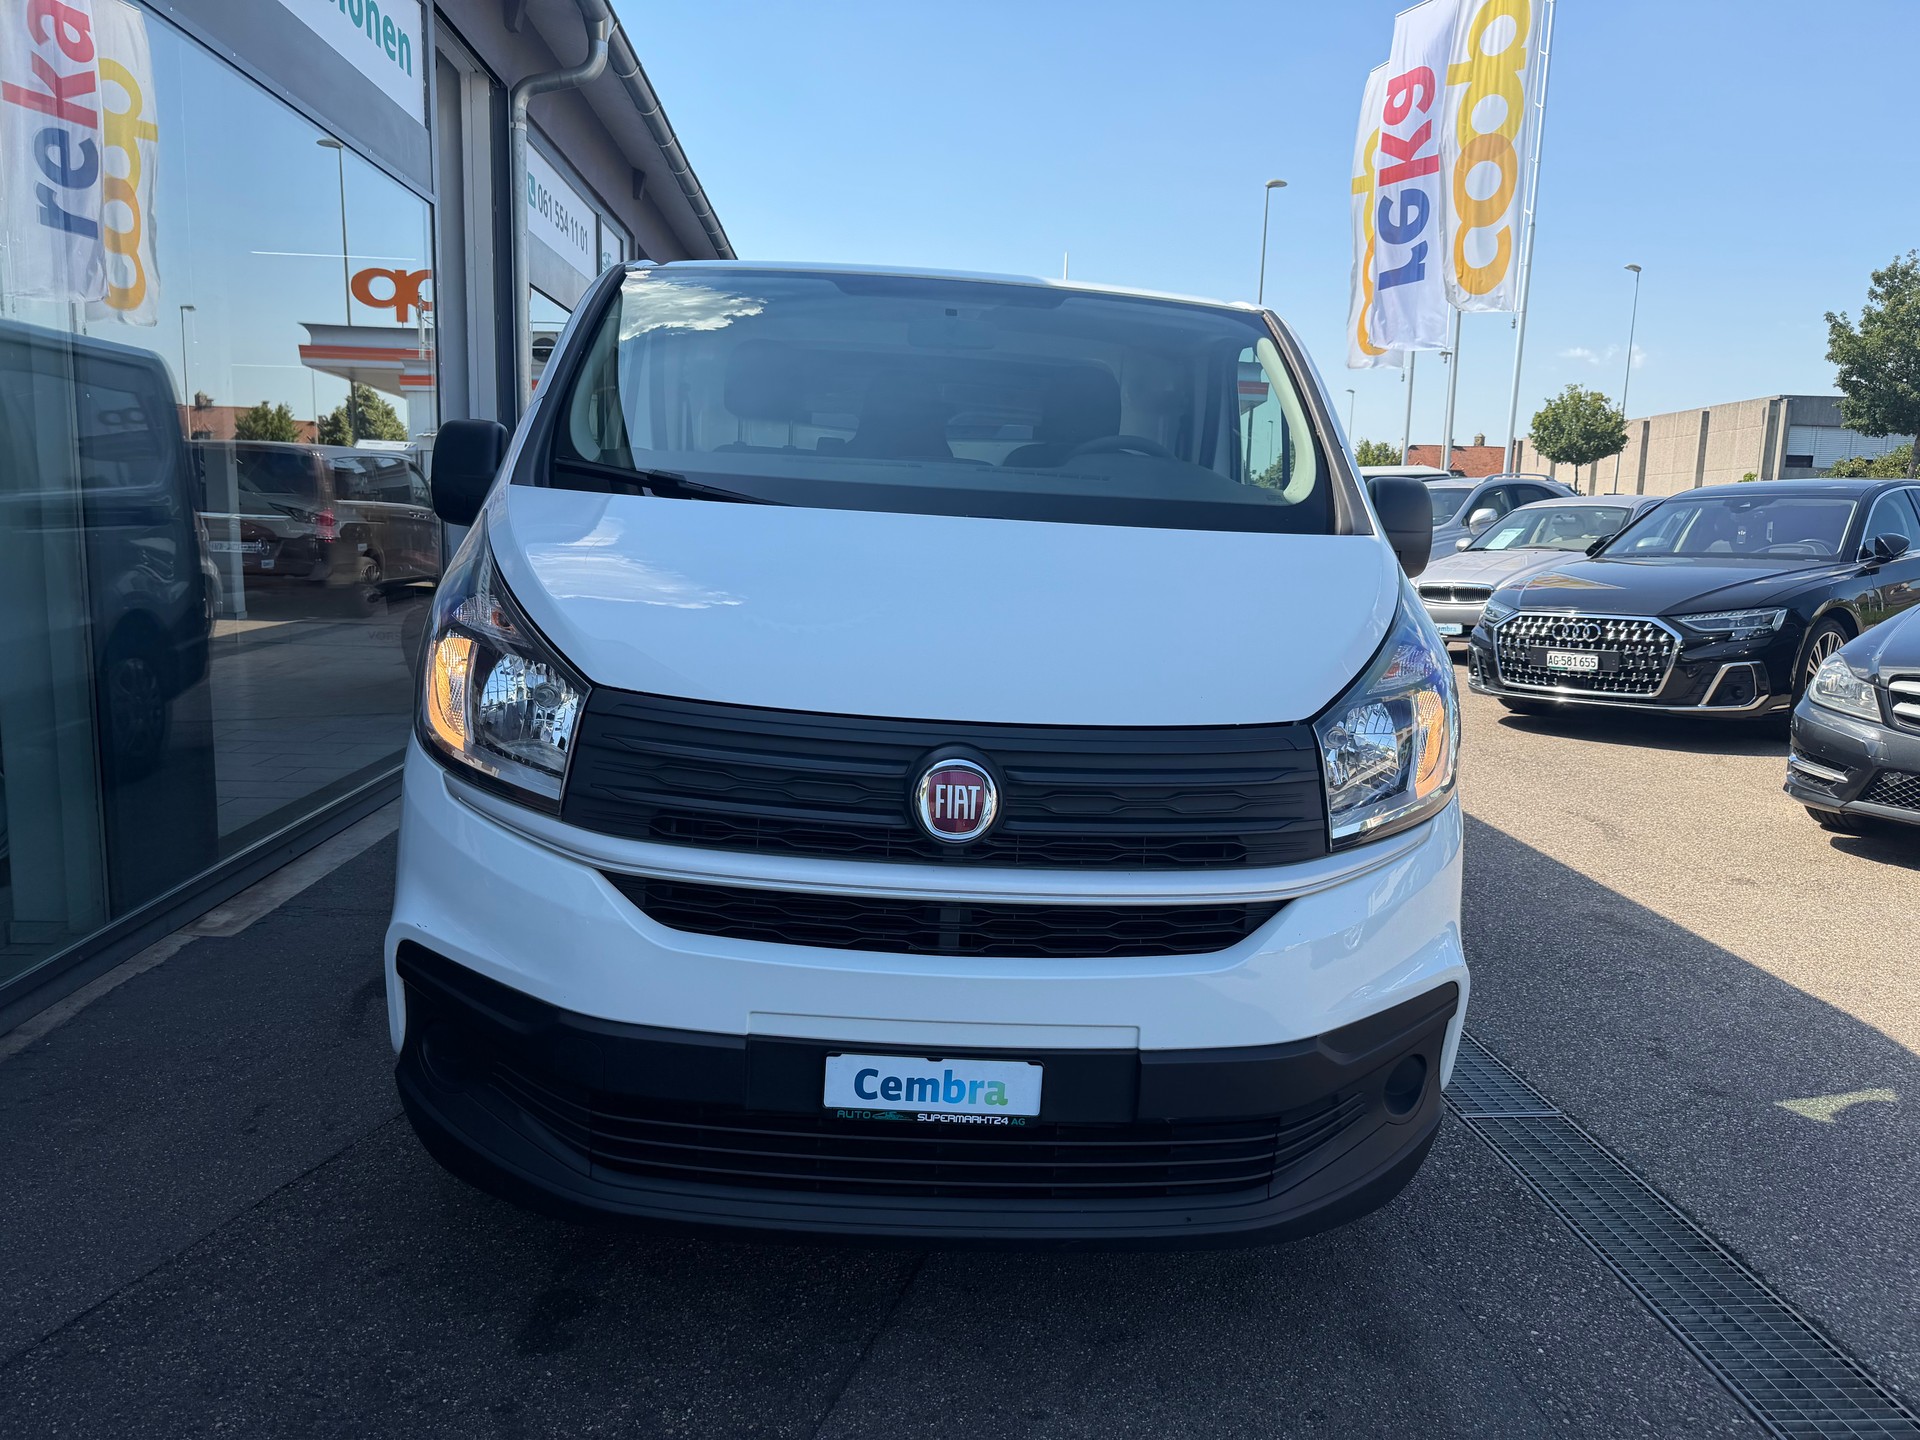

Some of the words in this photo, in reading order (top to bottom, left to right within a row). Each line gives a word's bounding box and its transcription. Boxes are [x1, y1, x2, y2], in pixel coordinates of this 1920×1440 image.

[1, 0, 98, 240] reka
[537, 183, 553, 223] 061
[555, 199, 569, 237] 554
[570, 216, 579, 248] 11
[580, 225, 588, 255] 01
[935, 784, 980, 820] FIAT
[854, 1068, 1009, 1106] Cembra
[837, 1109, 871, 1120] AUTO
[1011, 1118, 1026, 1126] AG
